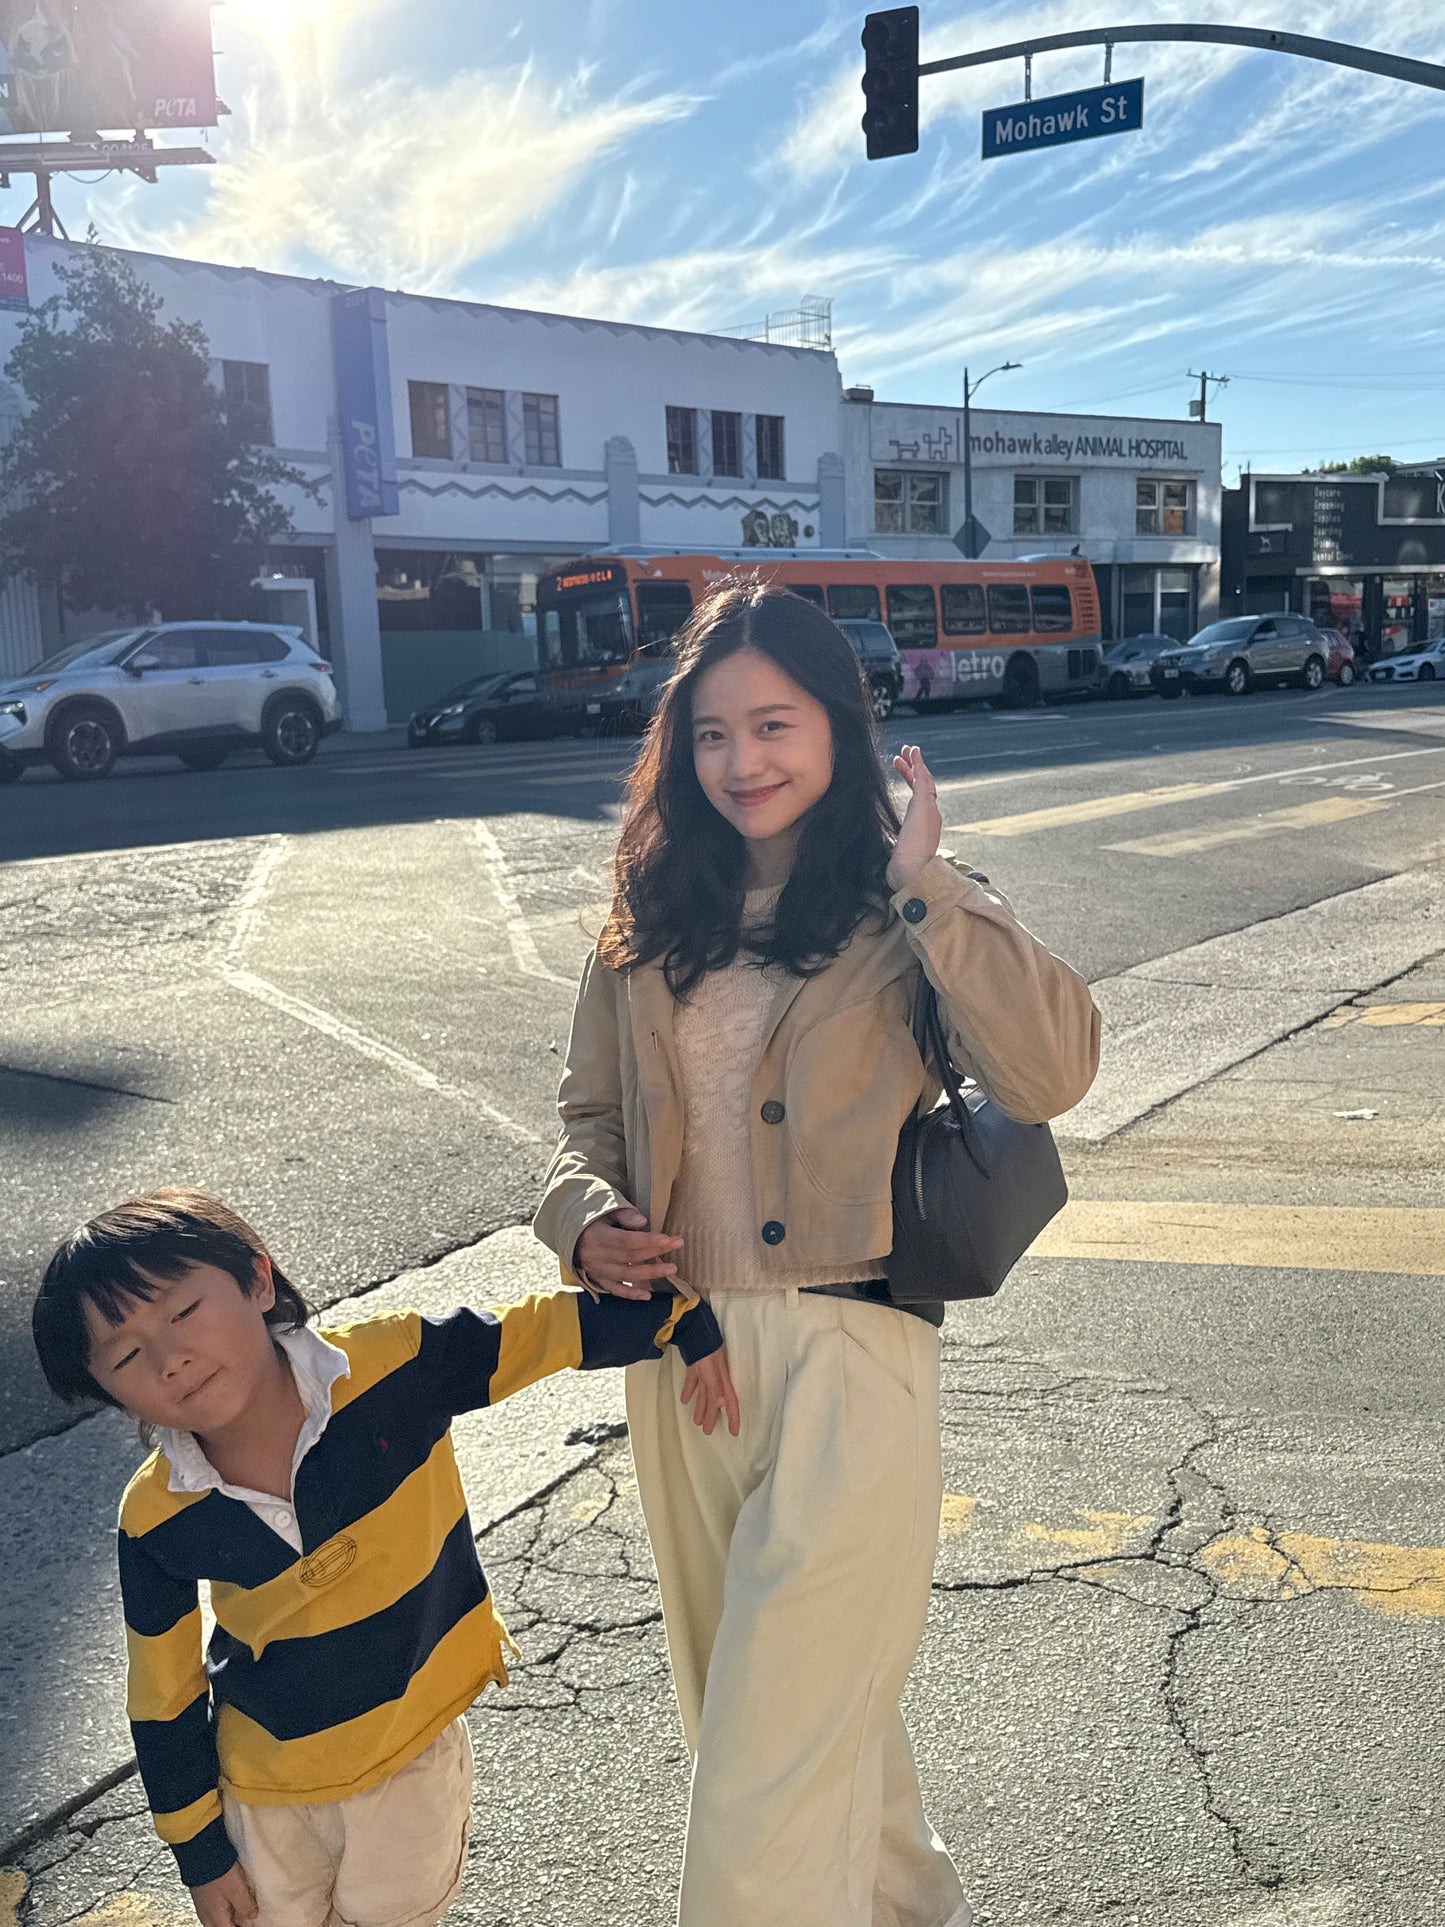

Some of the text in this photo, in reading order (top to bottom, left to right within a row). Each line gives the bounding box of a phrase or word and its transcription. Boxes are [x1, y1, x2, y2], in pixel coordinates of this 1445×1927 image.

[995, 95, 1128, 144] Mohawk St
[1075, 436, 1127, 458] ANIMAL
[1128, 438, 1188, 460] HOSPITAL
